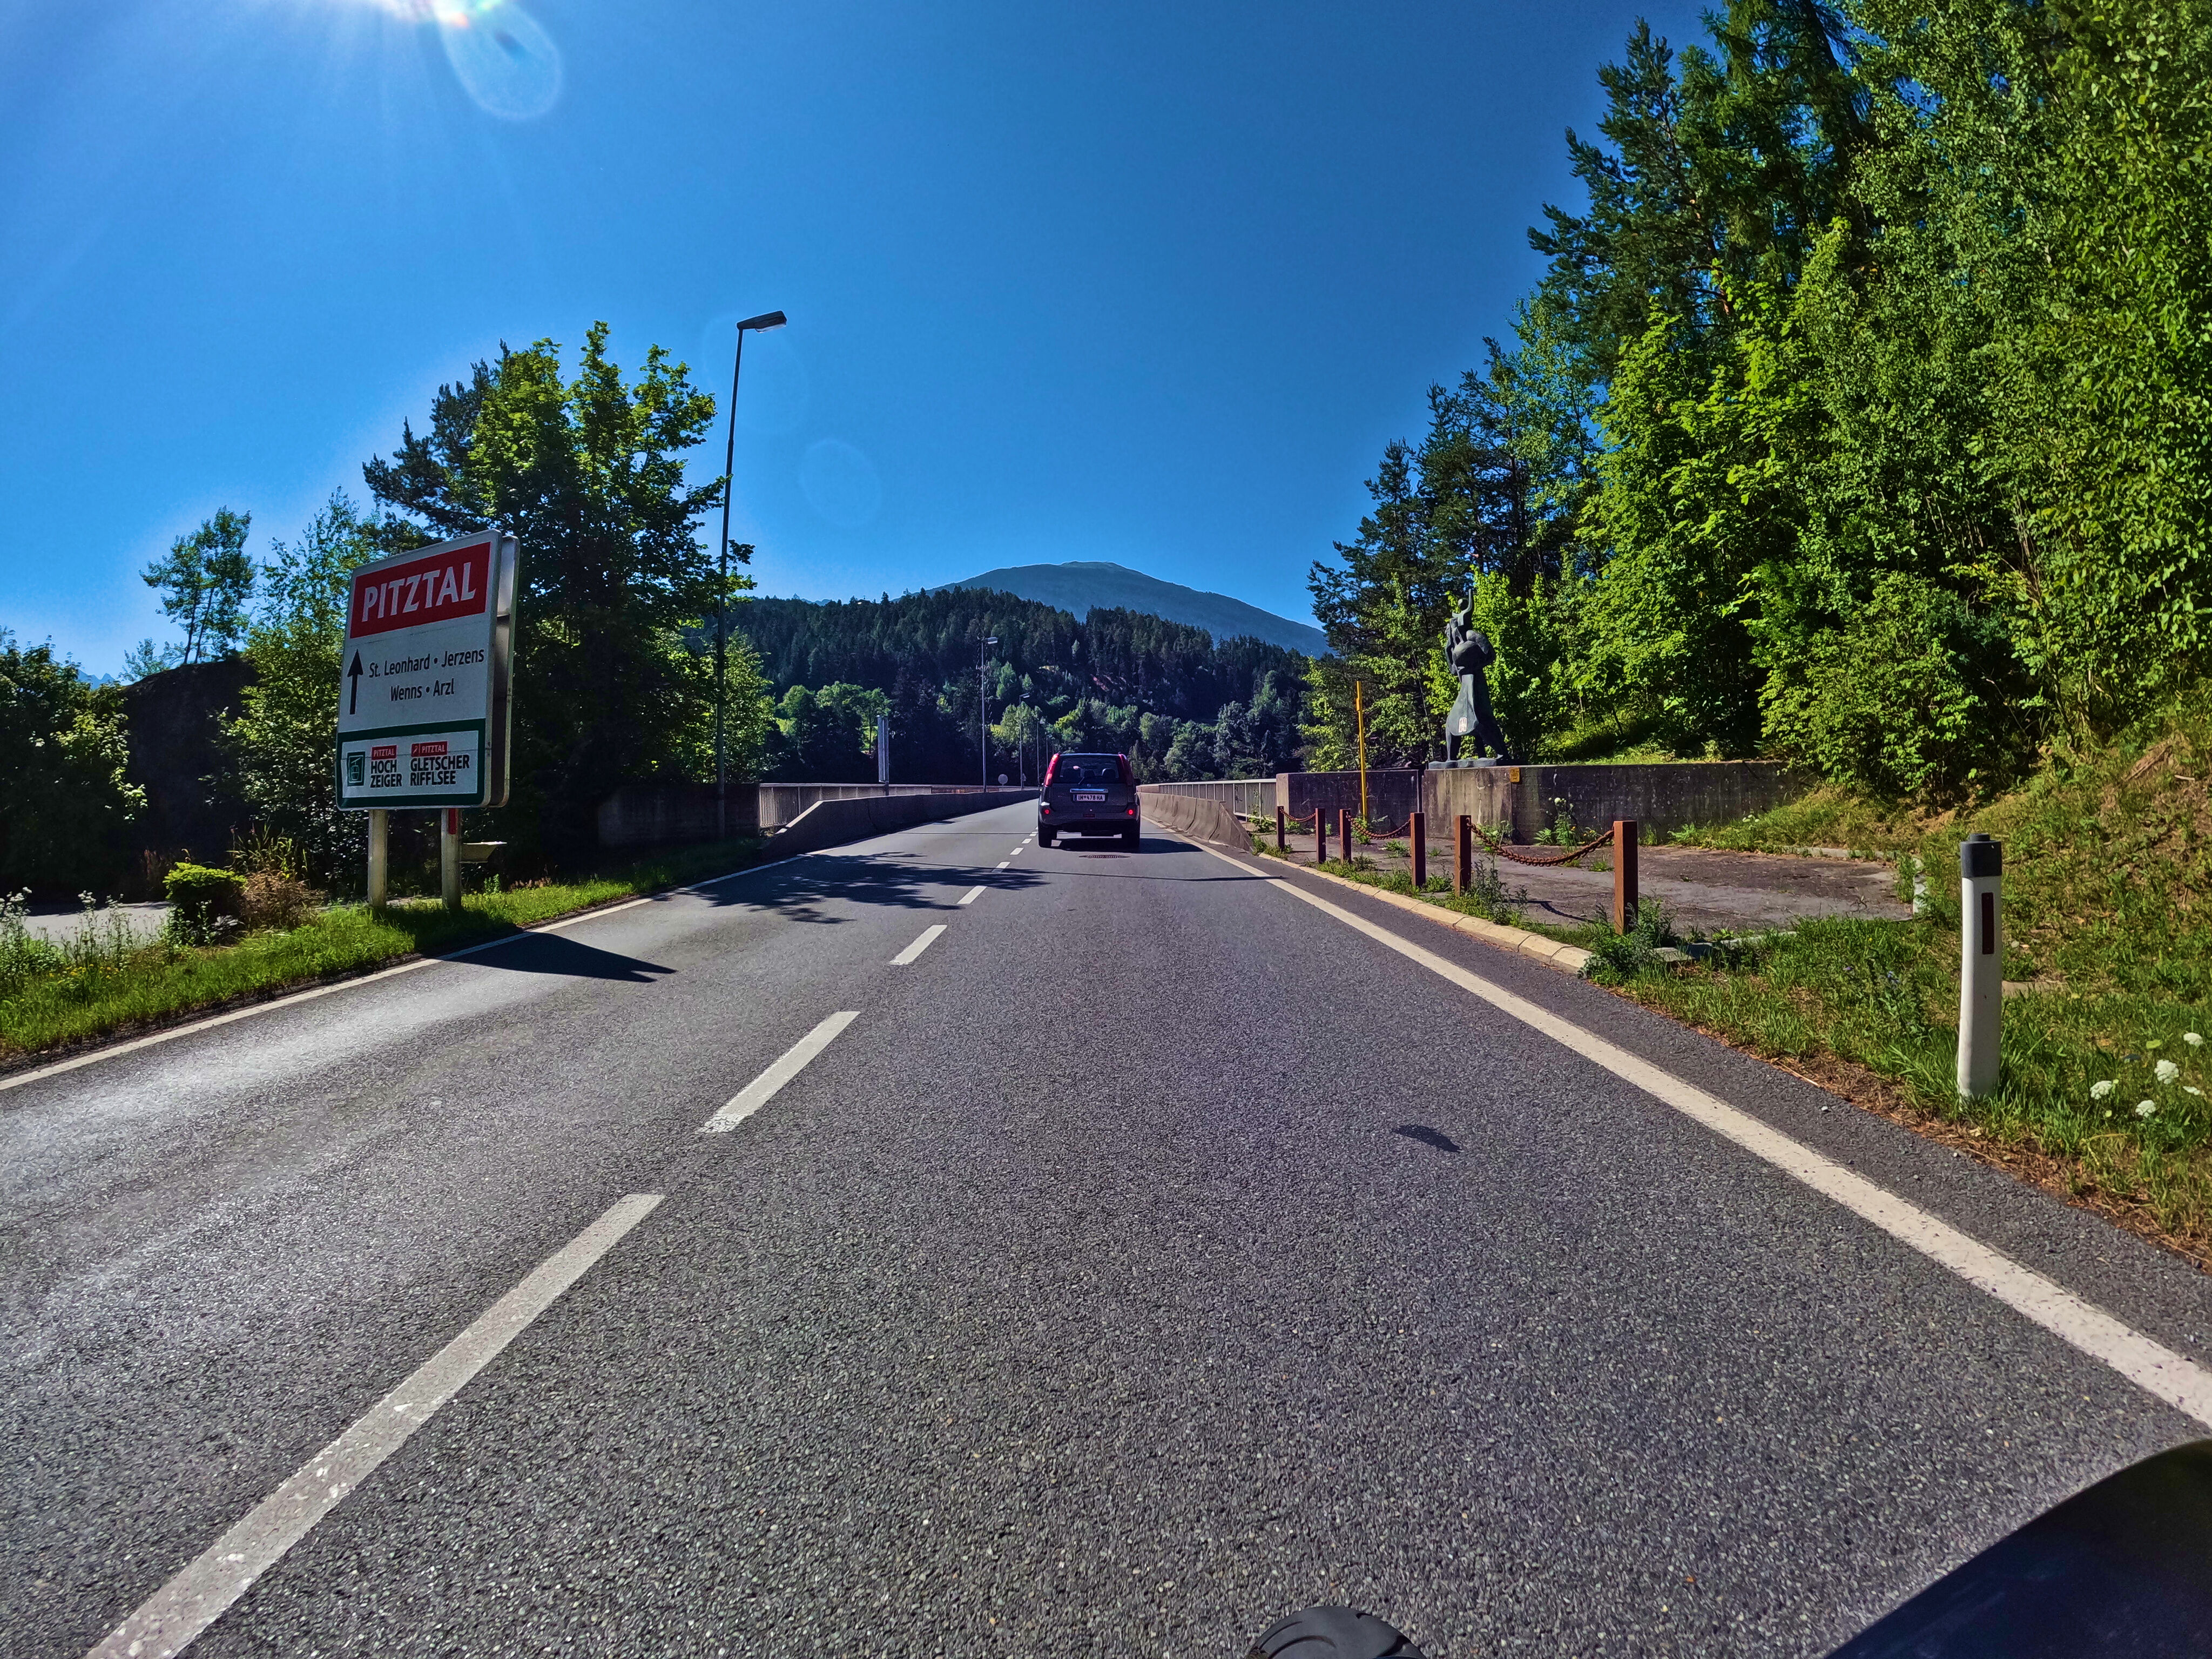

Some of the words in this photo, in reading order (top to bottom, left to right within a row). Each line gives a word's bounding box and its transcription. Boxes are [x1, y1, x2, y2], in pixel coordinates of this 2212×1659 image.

[361, 562, 476, 622] PITZTAL
[369, 662, 380, 678] St.
[384, 653, 430, 676] Leonhard
[441, 649, 484, 667] Jerzens
[390, 685, 422, 702] Wenns
[433, 678, 454, 696] Arzl
[374, 748, 395, 757] PITZTAL
[422, 744, 446, 753] PITZTAL
[371, 760, 397, 774] HOCH
[410, 754, 470, 772] GLETSCHER
[370, 773, 402, 788] ZEIGER
[410, 771, 456, 786] RIFFLSEE
